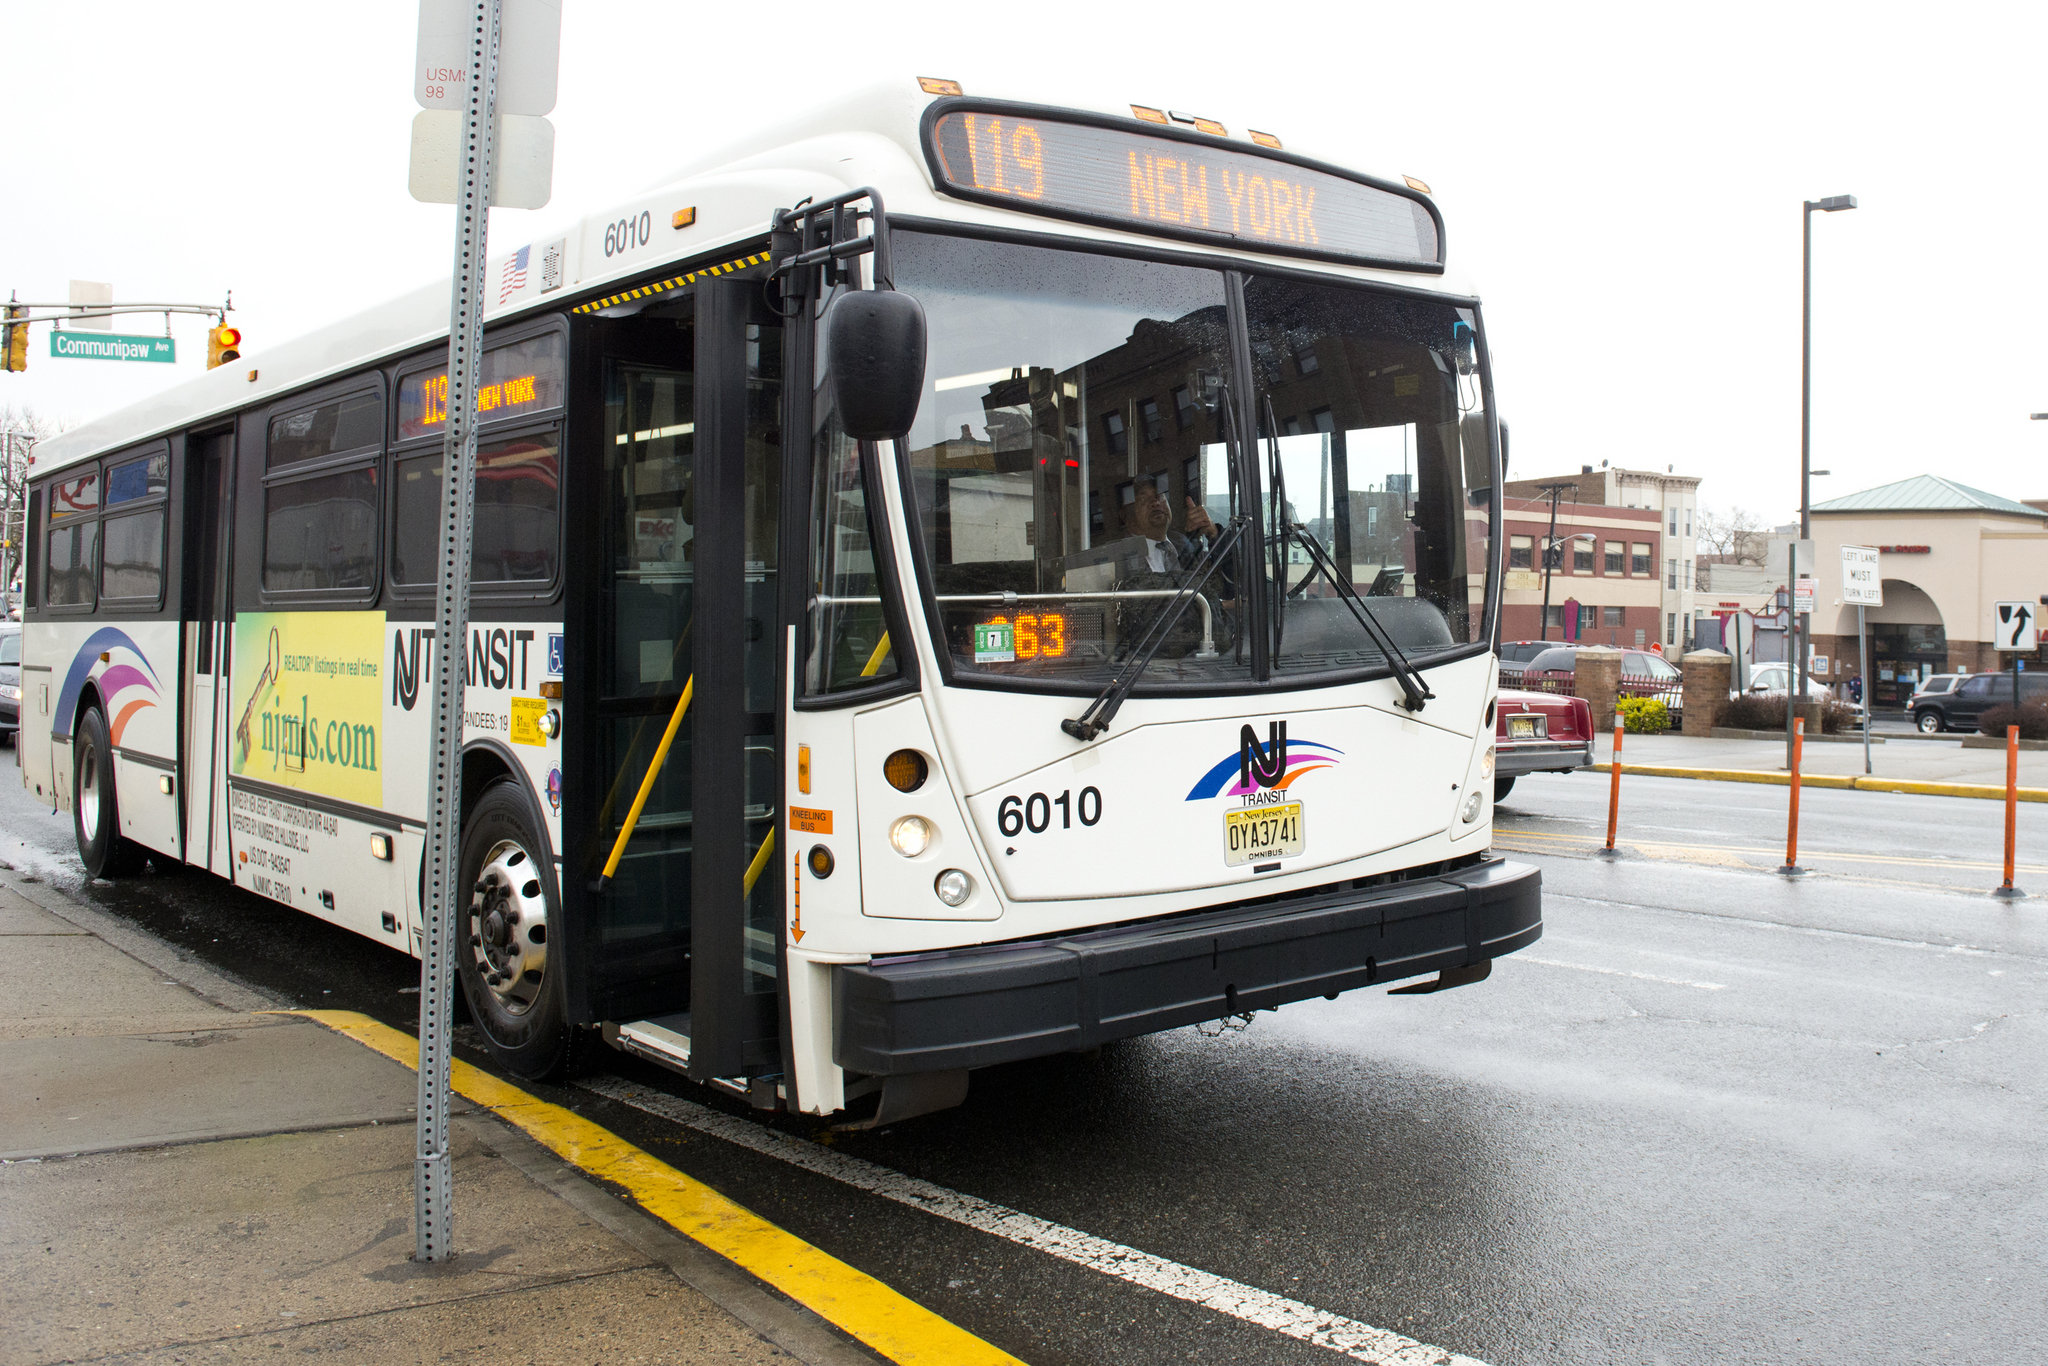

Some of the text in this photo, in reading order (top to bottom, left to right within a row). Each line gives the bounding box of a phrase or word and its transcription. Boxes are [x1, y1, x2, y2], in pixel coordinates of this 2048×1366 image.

[425, 85, 445, 99] 98
[964, 113, 1319, 245] 119 NEW YORK
[604, 210, 651, 258] 6010
[57, 335, 169, 360] Communipaw Ave
[424, 374, 536, 425] 119 NEW YORK
[1843, 551, 1877, 563] LEFT LANE
[1850, 570, 1871, 581] MUST
[1845, 588, 1879, 599] TURN LEFT
[991, 615, 1064, 657] 63
[315, 656, 338, 679] listings
[338, 657, 345, 674] in
[346, 658, 360, 676] real
[361, 658, 378, 677] time
[422, 628, 535, 690] TNSIT
[464, 711, 497, 729] ANDEES:
[499, 715, 509, 731] 19
[261, 694, 378, 772] njmls.com
[1240, 720, 1287, 788] NJ
[1241, 790, 1288, 806] TRANSIT
[269, 801, 282, 820] TRANSIT
[282, 804, 307, 827] CORPORATION
[792, 809, 826, 822] KNEELING
[997, 786, 1103, 837] 6010
[1244, 809, 1284, 821] New Jersey
[800, 821, 815, 832] BUS
[249, 845, 256, 864] US
[257, 847, 267, 868] DOT
[1248, 848, 1283, 860] OMNIBUS
